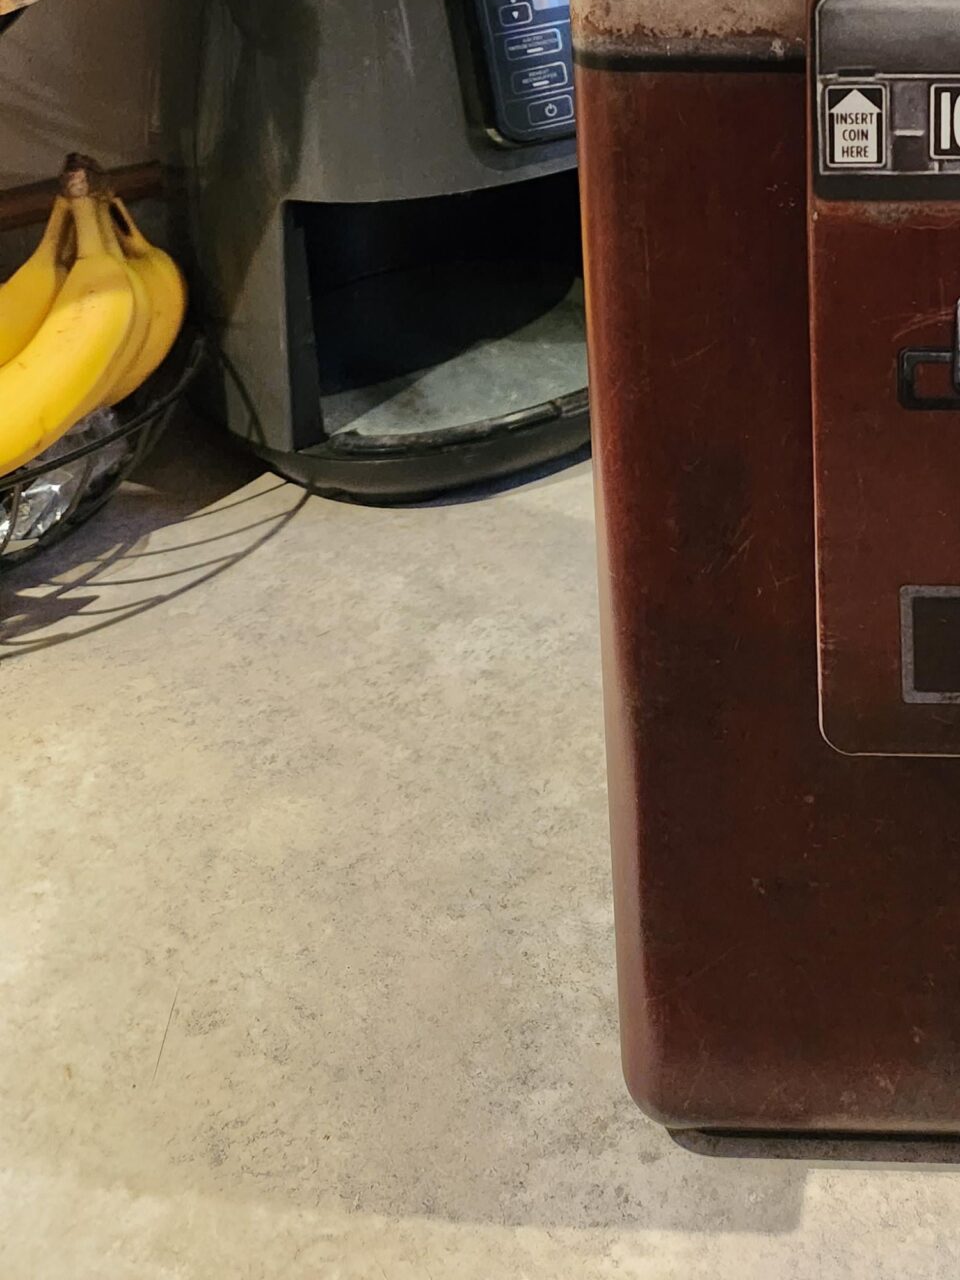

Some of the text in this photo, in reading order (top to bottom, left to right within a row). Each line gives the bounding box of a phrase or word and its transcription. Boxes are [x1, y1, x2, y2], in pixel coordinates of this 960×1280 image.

[835, 112, 875, 125] INSERT
[842, 128, 869, 142] COIN
[841, 145, 869, 158] HERE
